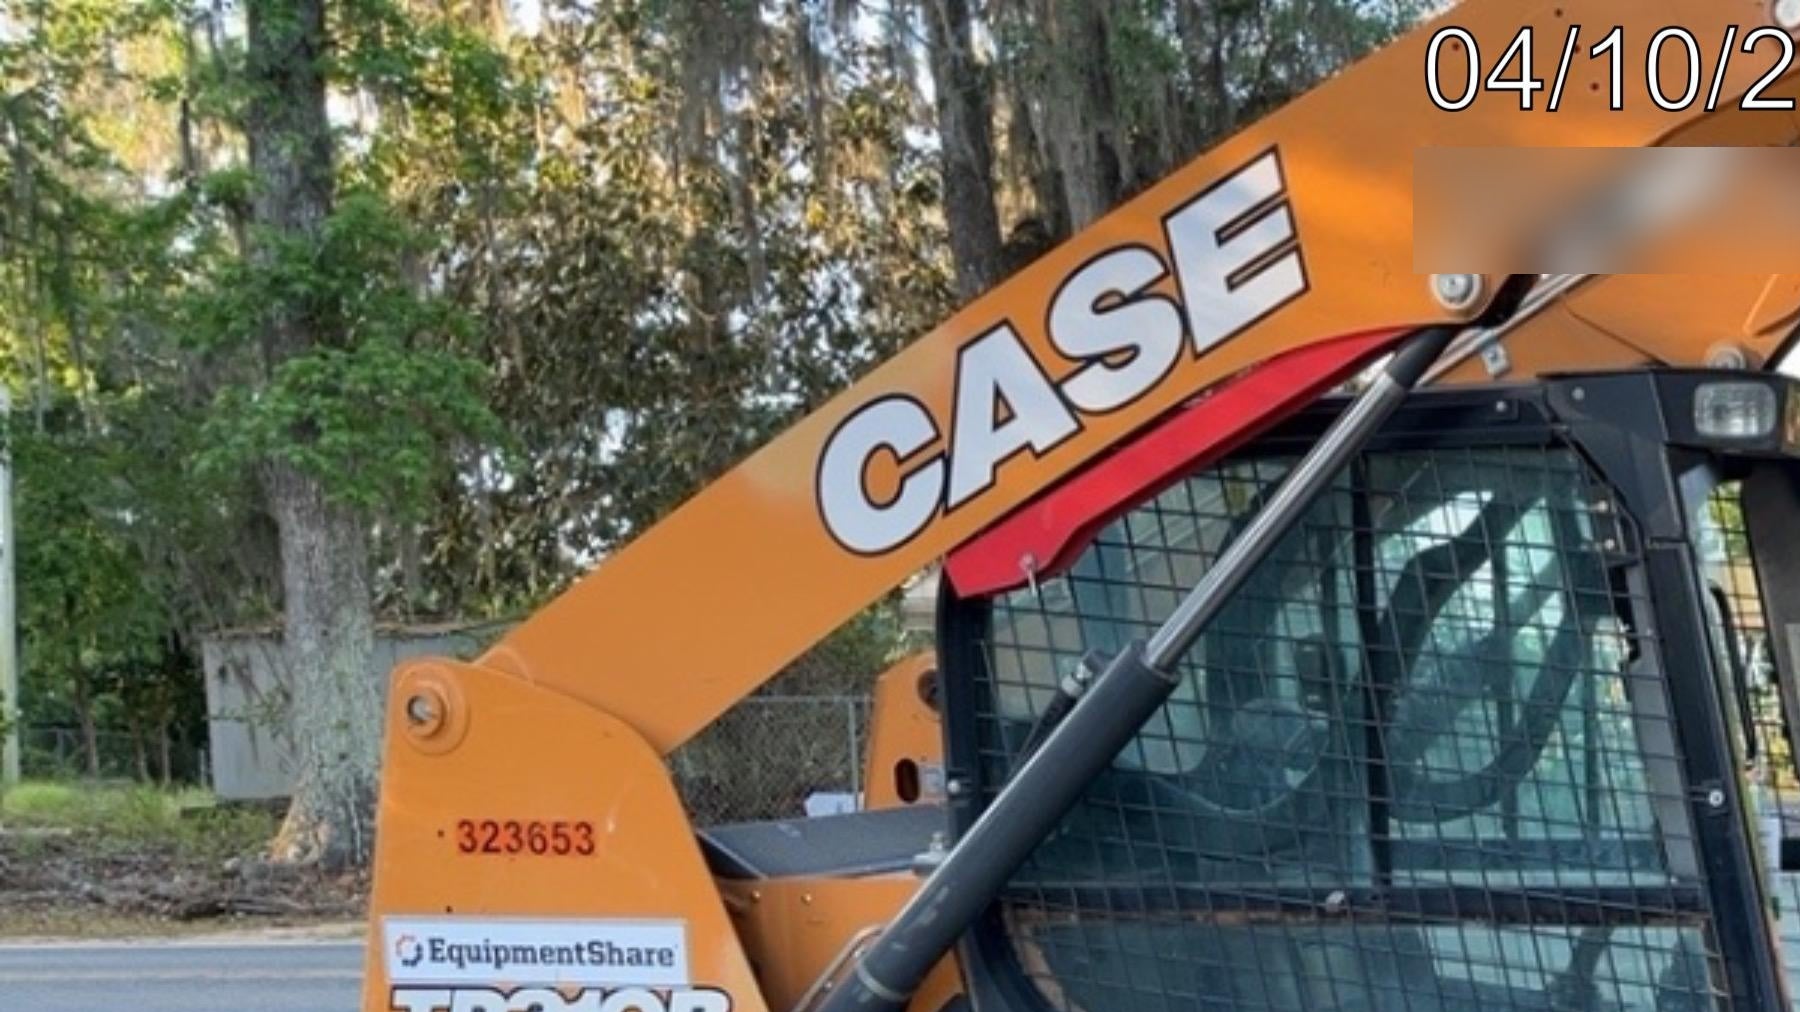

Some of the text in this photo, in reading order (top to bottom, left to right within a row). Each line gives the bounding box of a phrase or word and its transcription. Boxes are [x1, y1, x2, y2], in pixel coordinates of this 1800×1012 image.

[815, 144, 1311, 556] CASE
[457, 819, 597, 857] 323653
[427, 937, 676, 969] EquipmentShare
